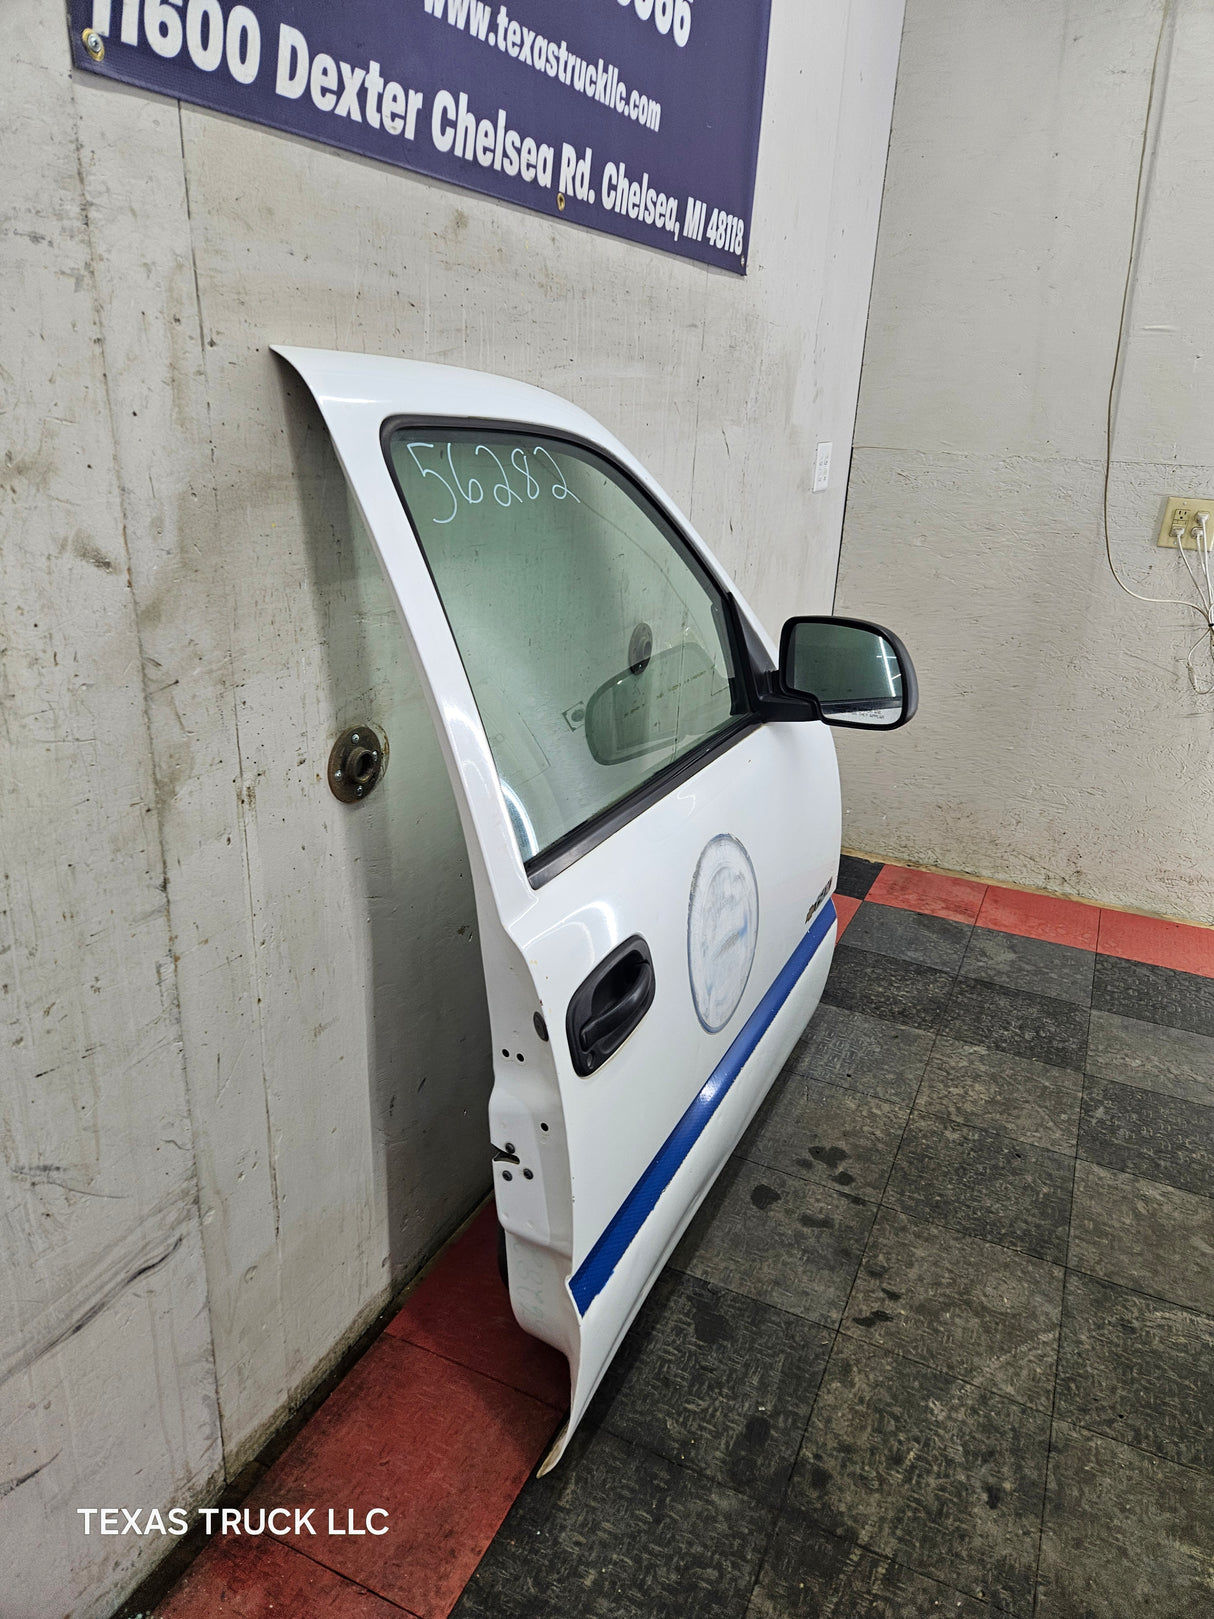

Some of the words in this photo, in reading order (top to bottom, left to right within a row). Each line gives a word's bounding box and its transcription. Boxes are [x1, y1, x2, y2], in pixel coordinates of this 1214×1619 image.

[275, 23, 423, 141] Dexter
[432, 90, 554, 189] Chelsea
[559, 142, 595, 204] Rd.
[602, 162, 680, 241] Chelsea,
[683, 197, 706, 241] MI
[706, 208, 744, 255] 48118
[407, 442, 581, 523] 56282
